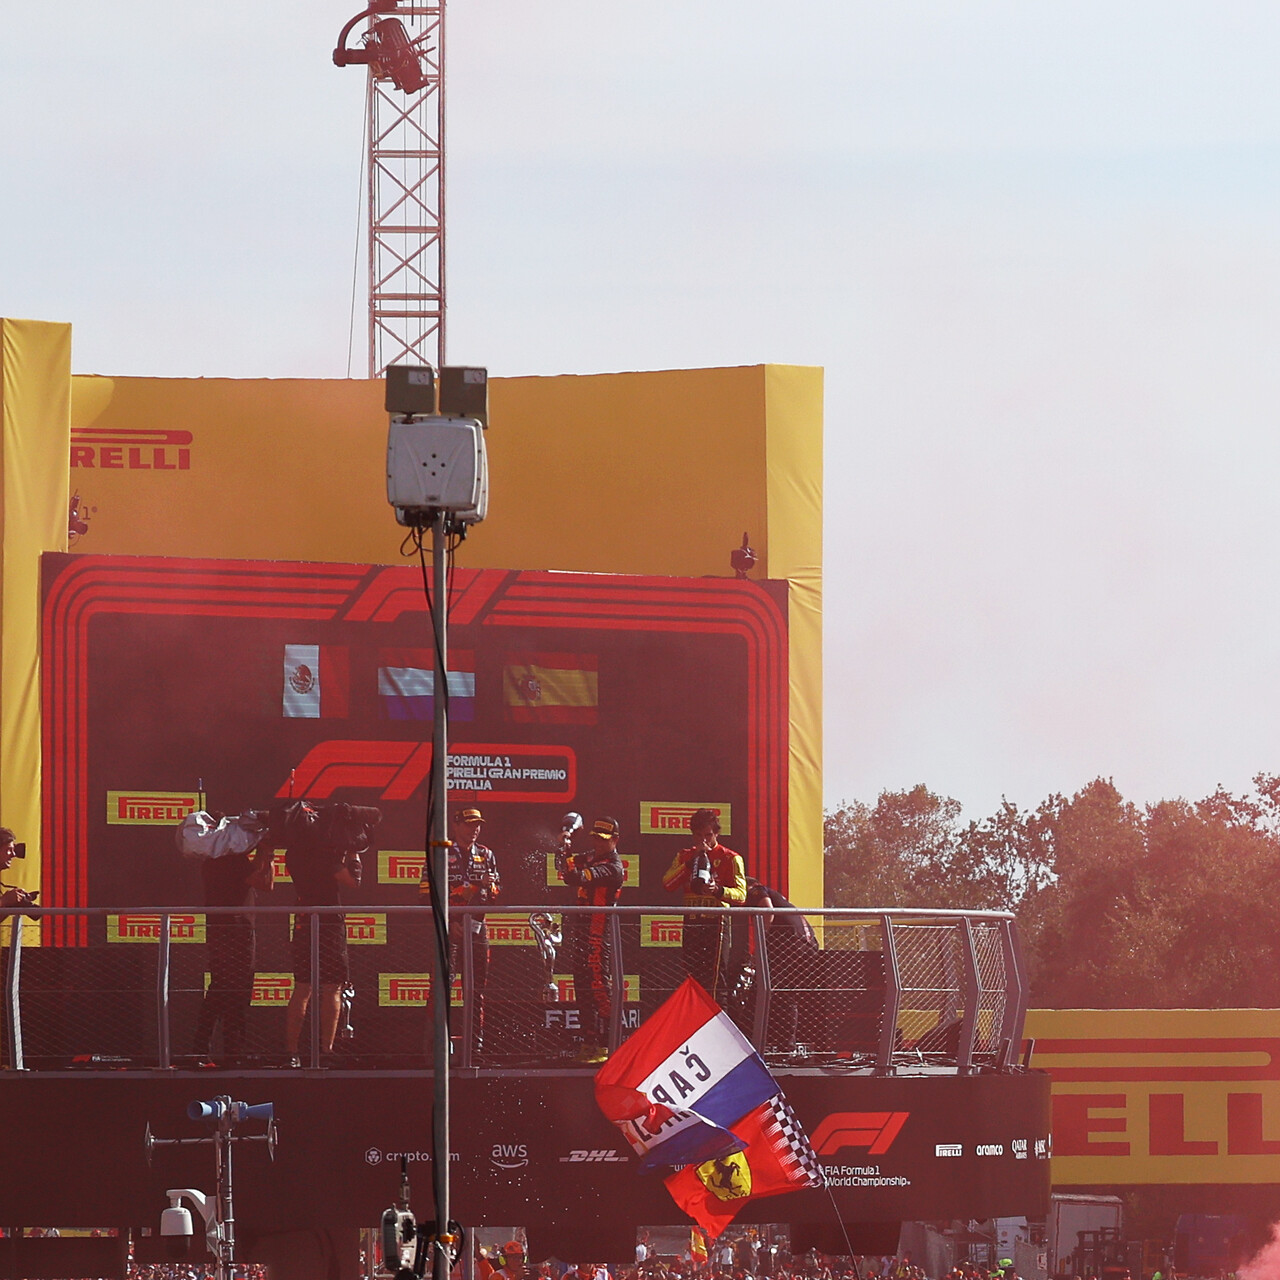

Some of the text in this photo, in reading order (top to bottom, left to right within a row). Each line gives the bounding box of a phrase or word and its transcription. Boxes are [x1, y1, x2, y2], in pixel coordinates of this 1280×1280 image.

[70, 428, 193, 470] RELLI
[446, 755, 511, 766] FORMULA 1
[446, 767, 566, 780] PIRELLI GRAN PREMIO
[545, 1009, 641, 1030] FEARI
[492, 1143, 528, 1158] aws
[568, 1150, 620, 1162] DHL
[936, 1144, 963, 1157] PIRELLI
[976, 1144, 1003, 1156] aramco
[386, 1150, 460, 1164] crypto.m
[825, 1165, 880, 1175] FIA Formula 1
[826, 1176, 907, 1187] World Championship
